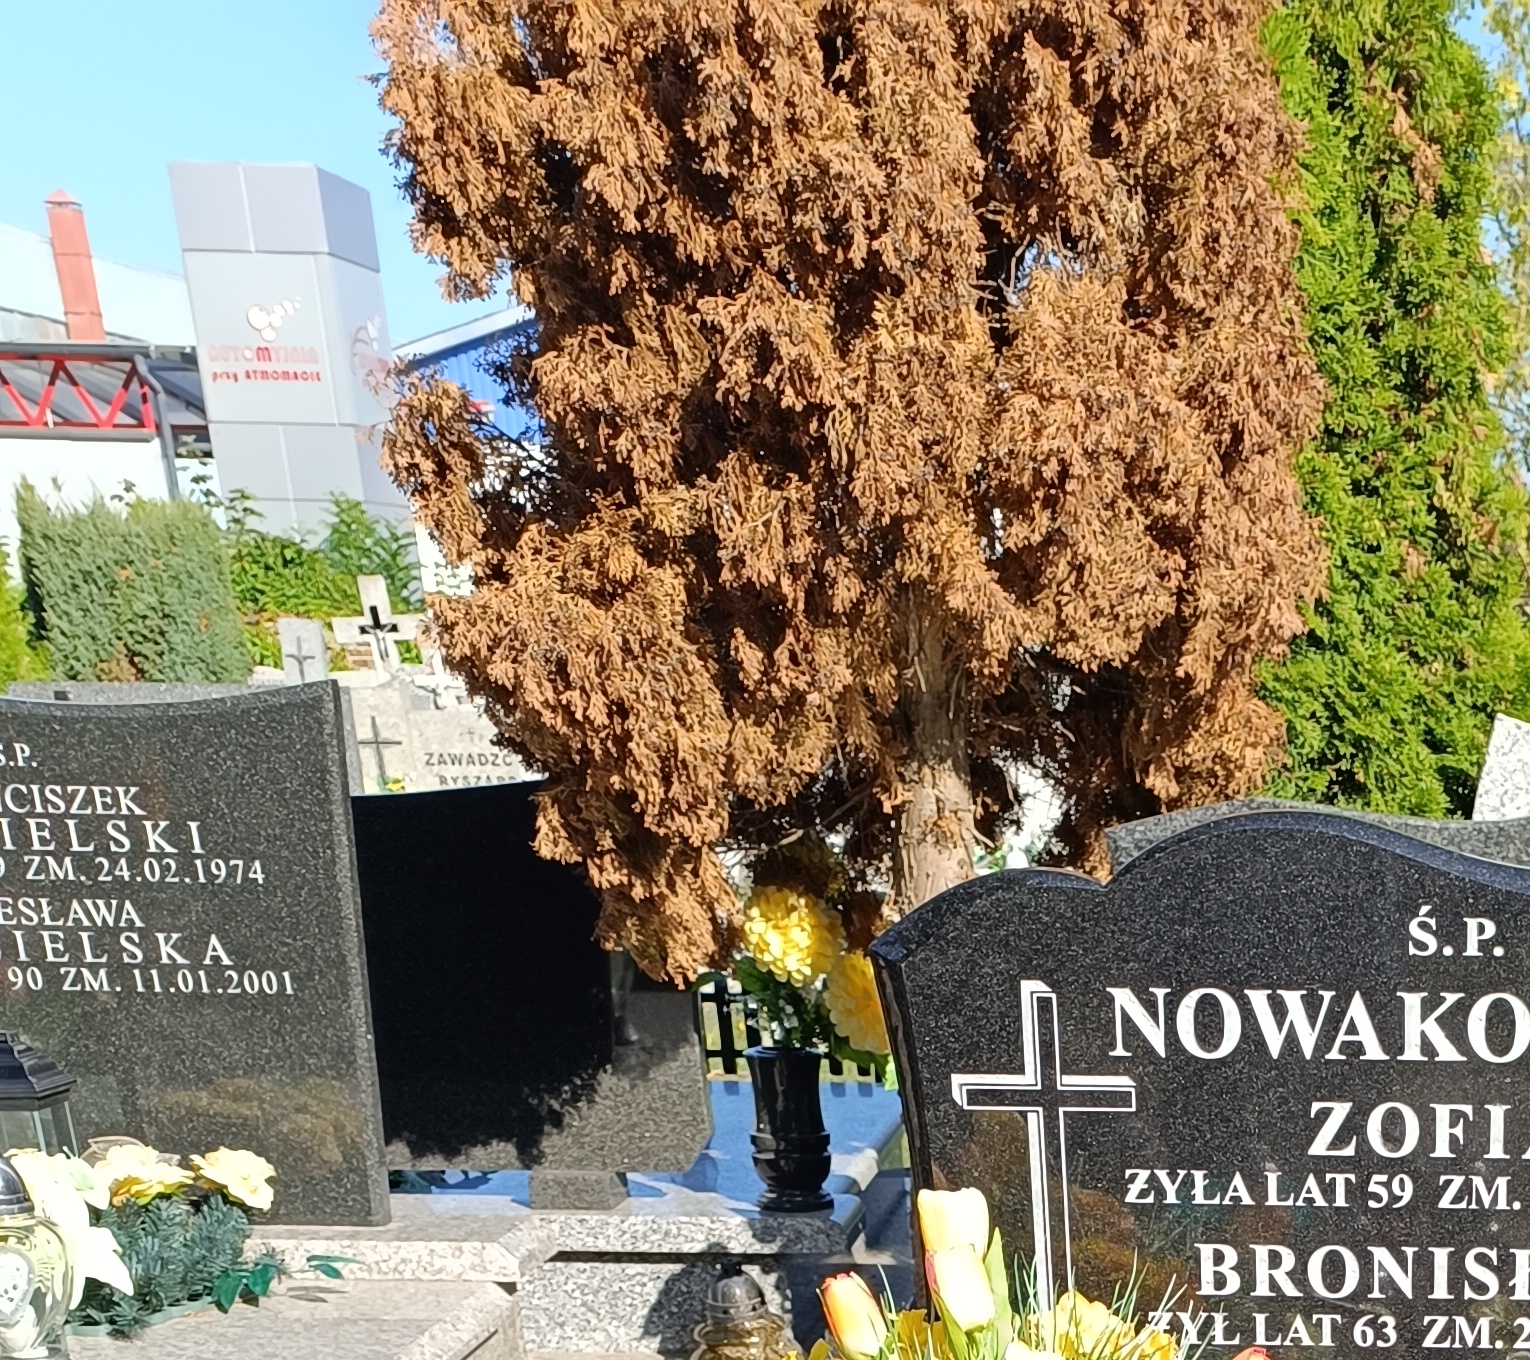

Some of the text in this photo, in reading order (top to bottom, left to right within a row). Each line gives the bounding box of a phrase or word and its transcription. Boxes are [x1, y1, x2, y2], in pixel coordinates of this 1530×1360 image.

[0, 783, 148, 816] CISZEK
[23, 855, 87, 882] ZM.
[94, 857, 266, 884] 24.02.1974
[7, 965, 296, 995] 90 ZM. 11.01.2001
[1262, 1171, 1357, 1208] LAT
[1366, 1173, 1415, 1210] 59
[1436, 1174, 1523, 1212] ZM.
[1250, 1312, 1343, 1348] LAT
[1351, 1313, 1399, 1349] 63
[1420, 1314, 1505, 1351] ZM.
